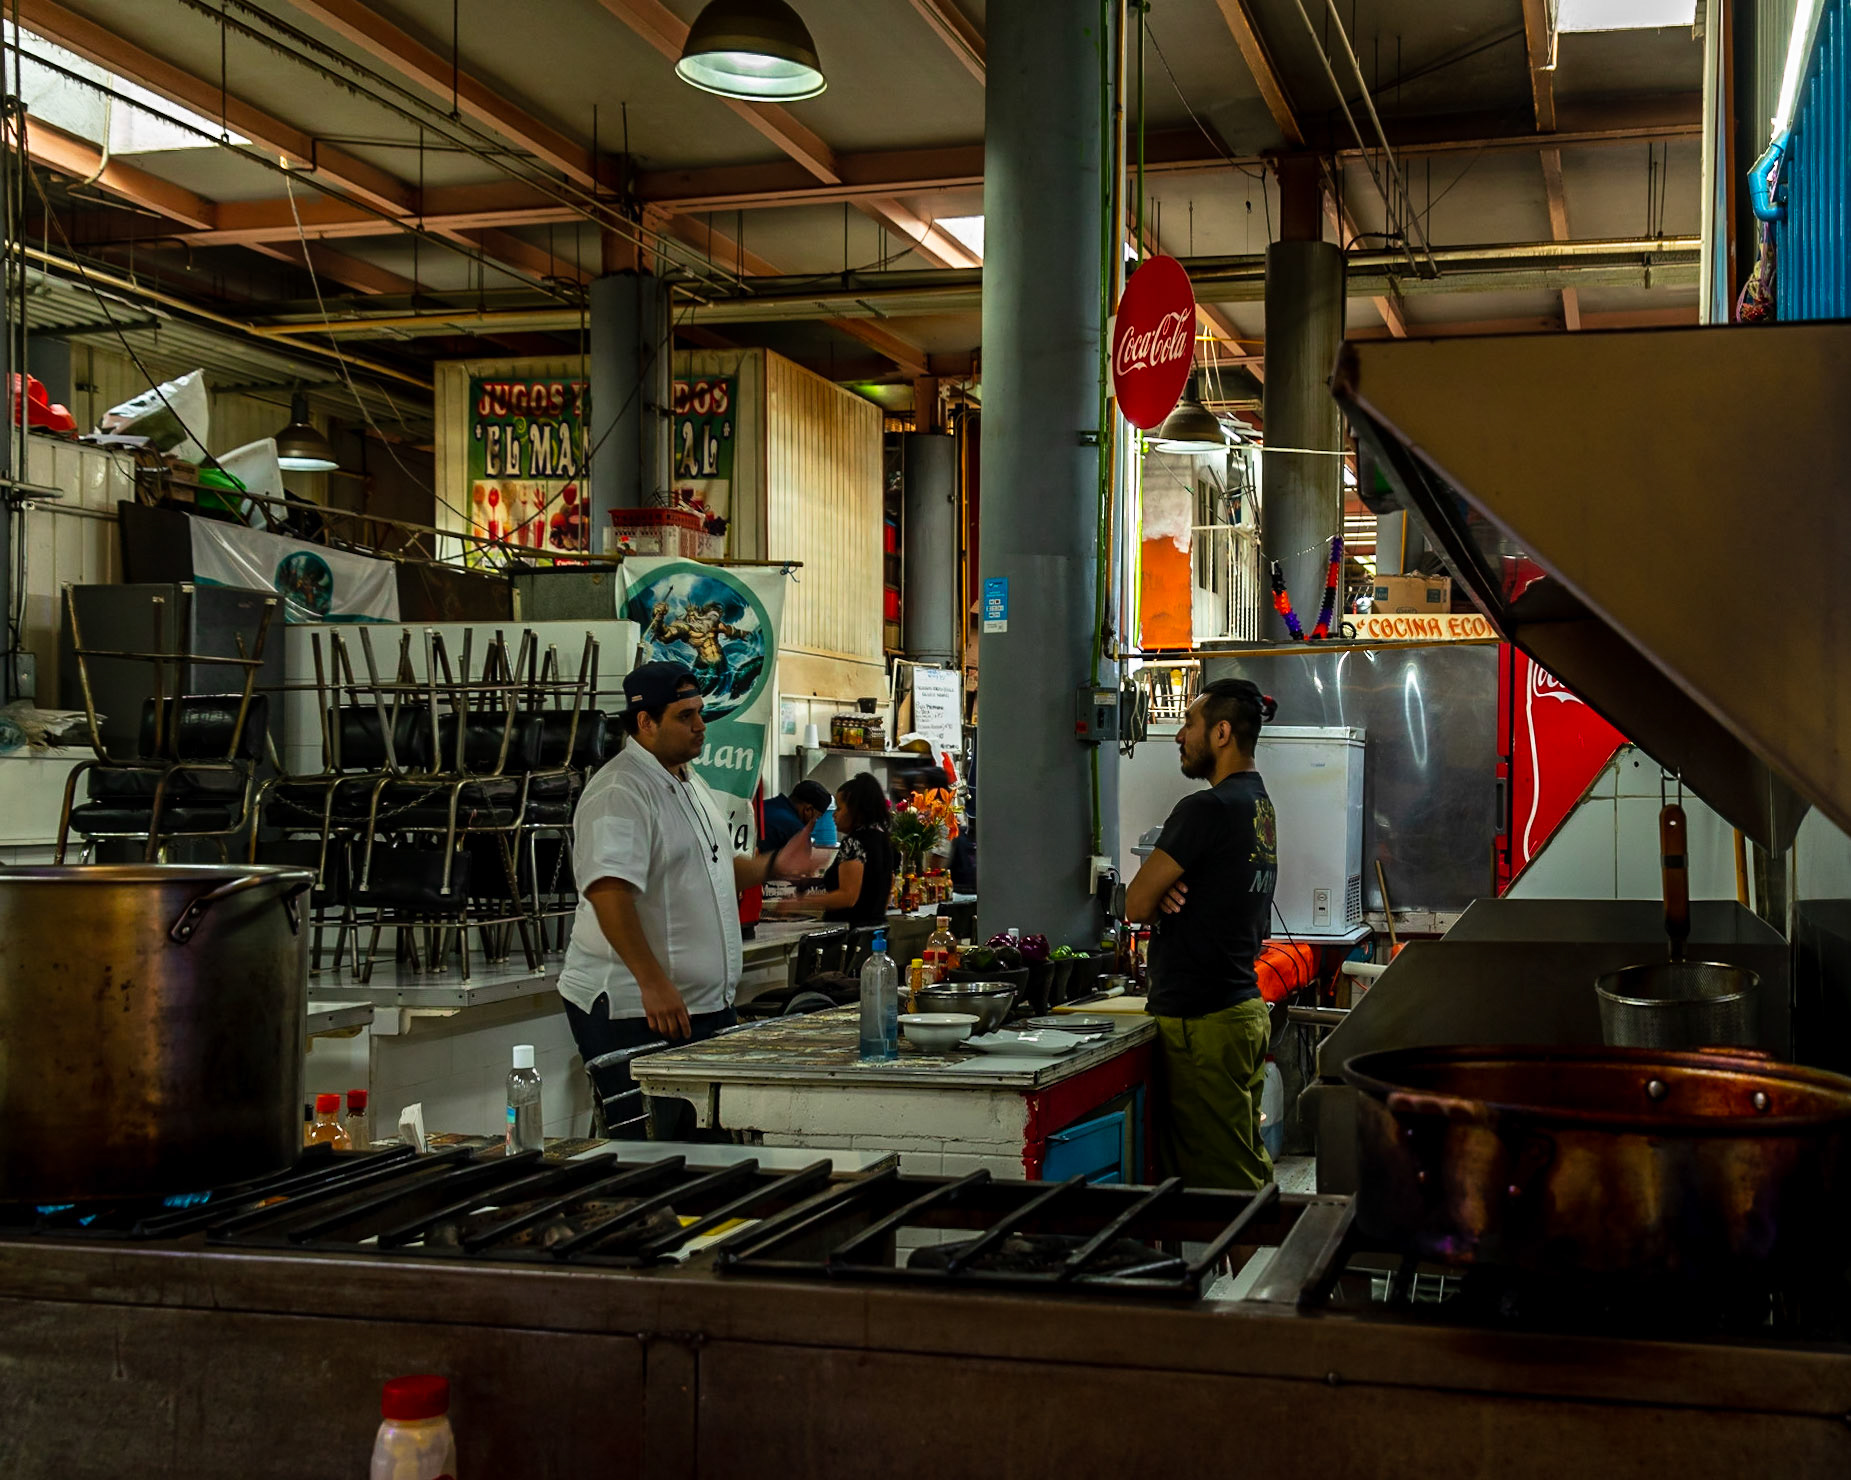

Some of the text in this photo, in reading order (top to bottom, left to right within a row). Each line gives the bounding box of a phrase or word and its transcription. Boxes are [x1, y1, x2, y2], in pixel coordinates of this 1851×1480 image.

[1116, 307, 1193, 377] Coca-Cola
[479, 383, 564, 416] JUGOS
[673, 382, 729, 415] DOS
[692, 743, 754, 772] uan
